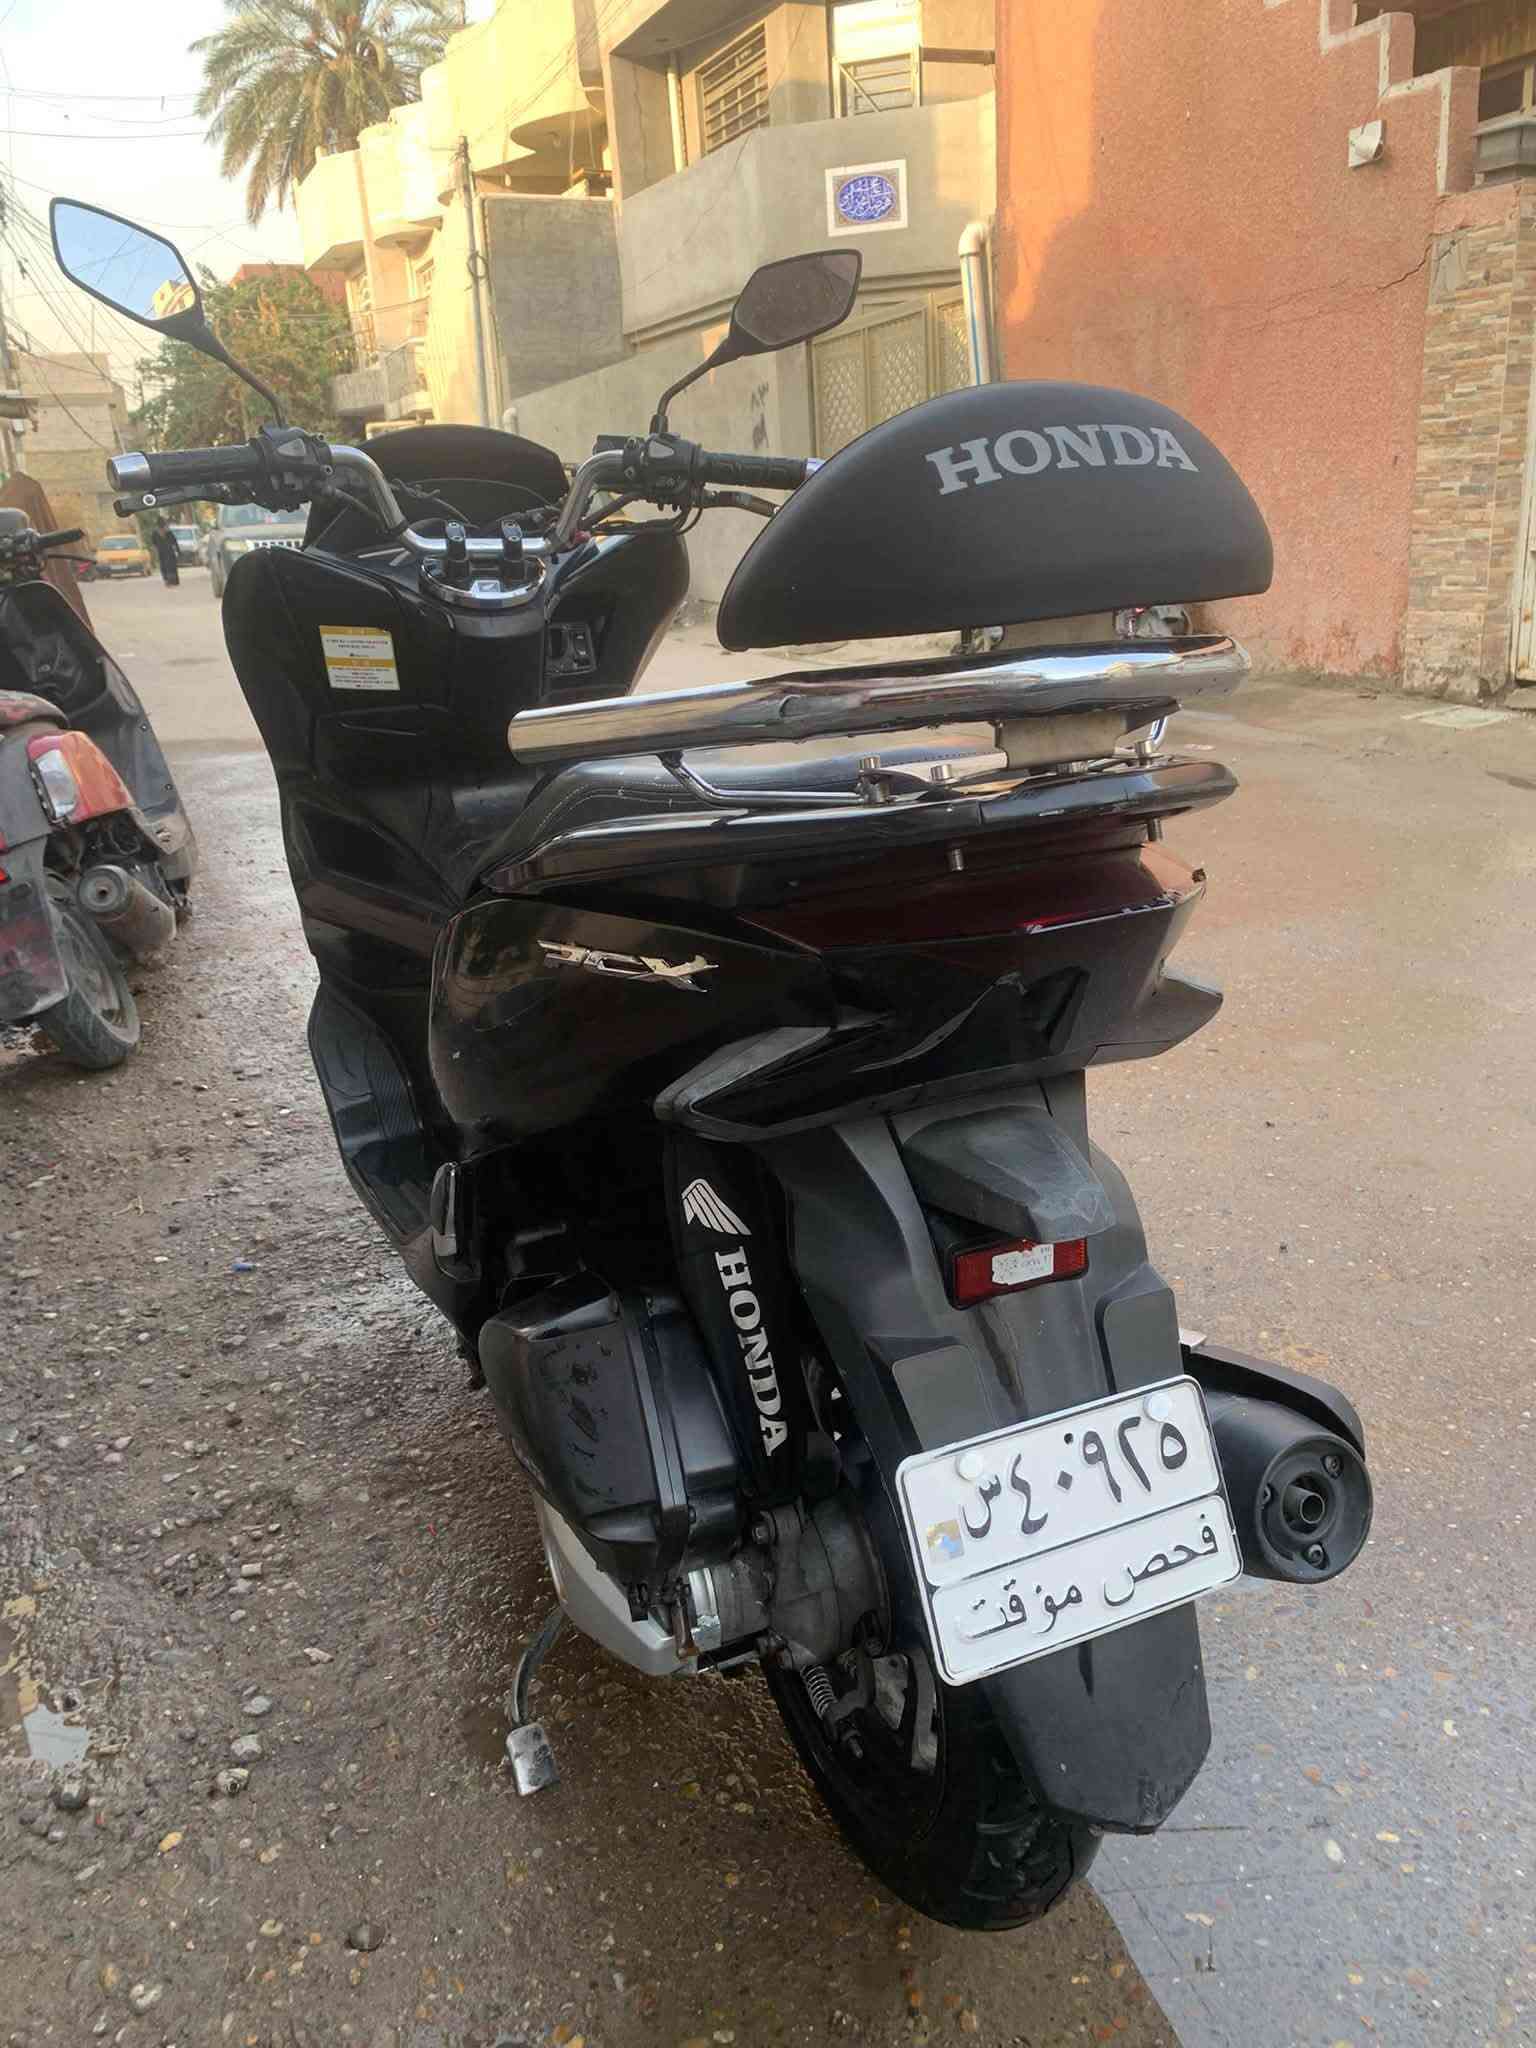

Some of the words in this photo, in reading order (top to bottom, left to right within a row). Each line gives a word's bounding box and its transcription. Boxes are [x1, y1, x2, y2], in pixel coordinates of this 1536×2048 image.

[925, 424, 1200, 496] HONDA
[715, 1246, 788, 1457] HONDA
[1103, 1512, 1220, 1607] فحص
